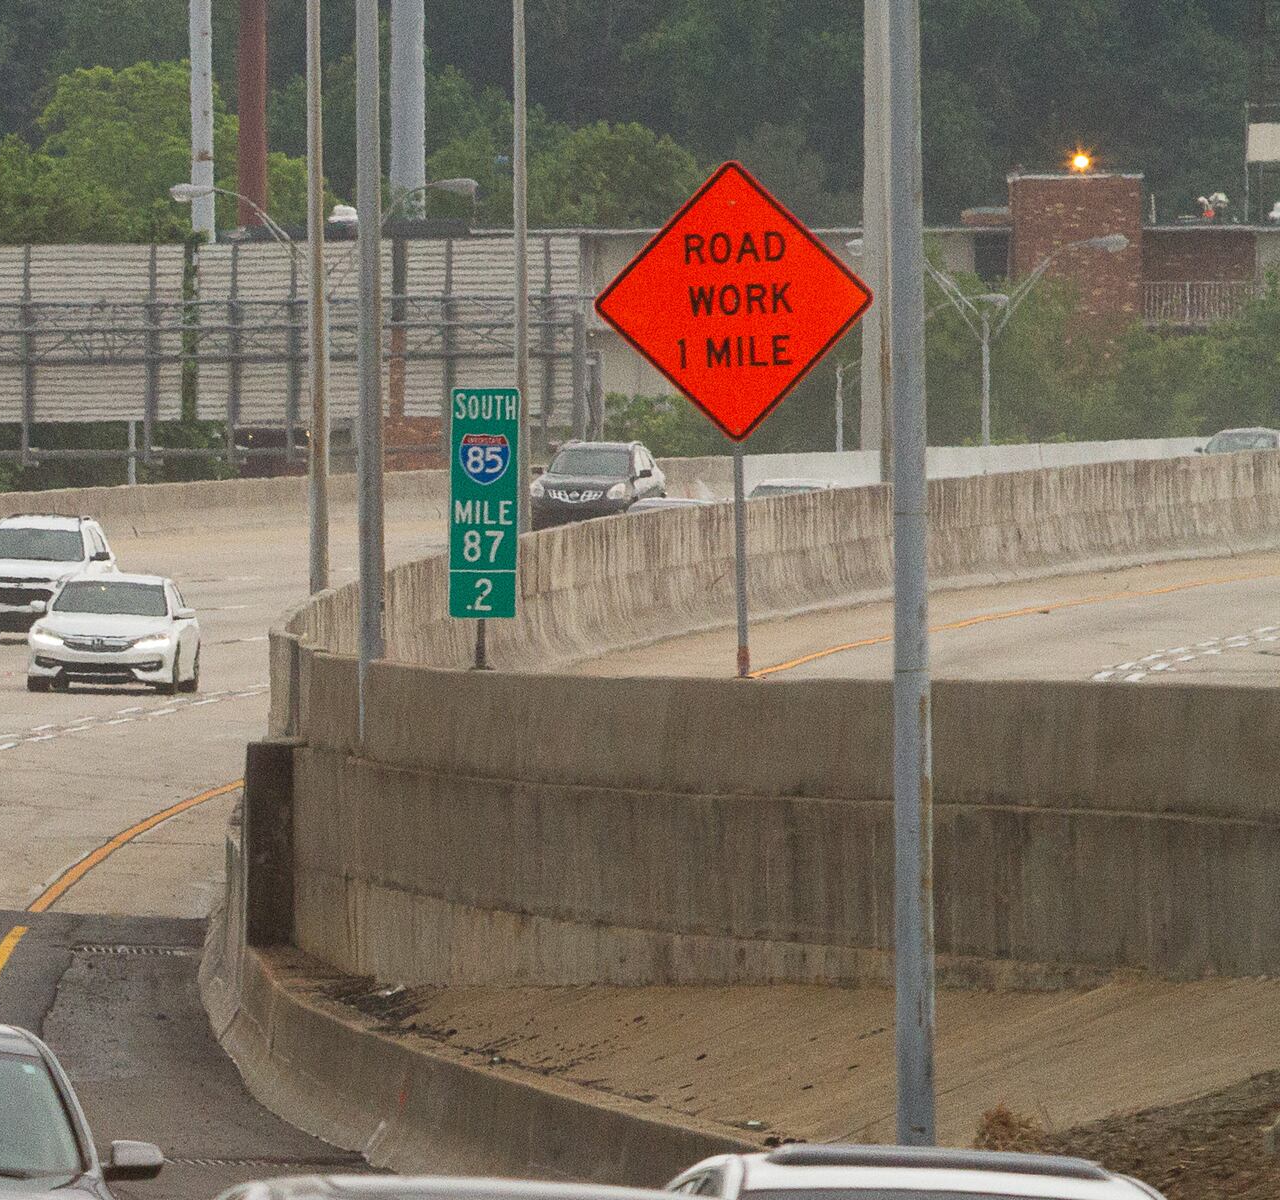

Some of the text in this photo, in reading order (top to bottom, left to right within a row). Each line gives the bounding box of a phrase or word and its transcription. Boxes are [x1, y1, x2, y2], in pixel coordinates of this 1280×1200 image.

[684, 231, 786, 265] ROAD
[688, 281, 793, 317] WORK
[677, 334, 792, 369] 1 MILE
[455, 393, 516, 420] SOUTH
[466, 446, 503, 474] 85
[455, 500, 513, 525] MILE
[463, 530, 505, 563] 87
